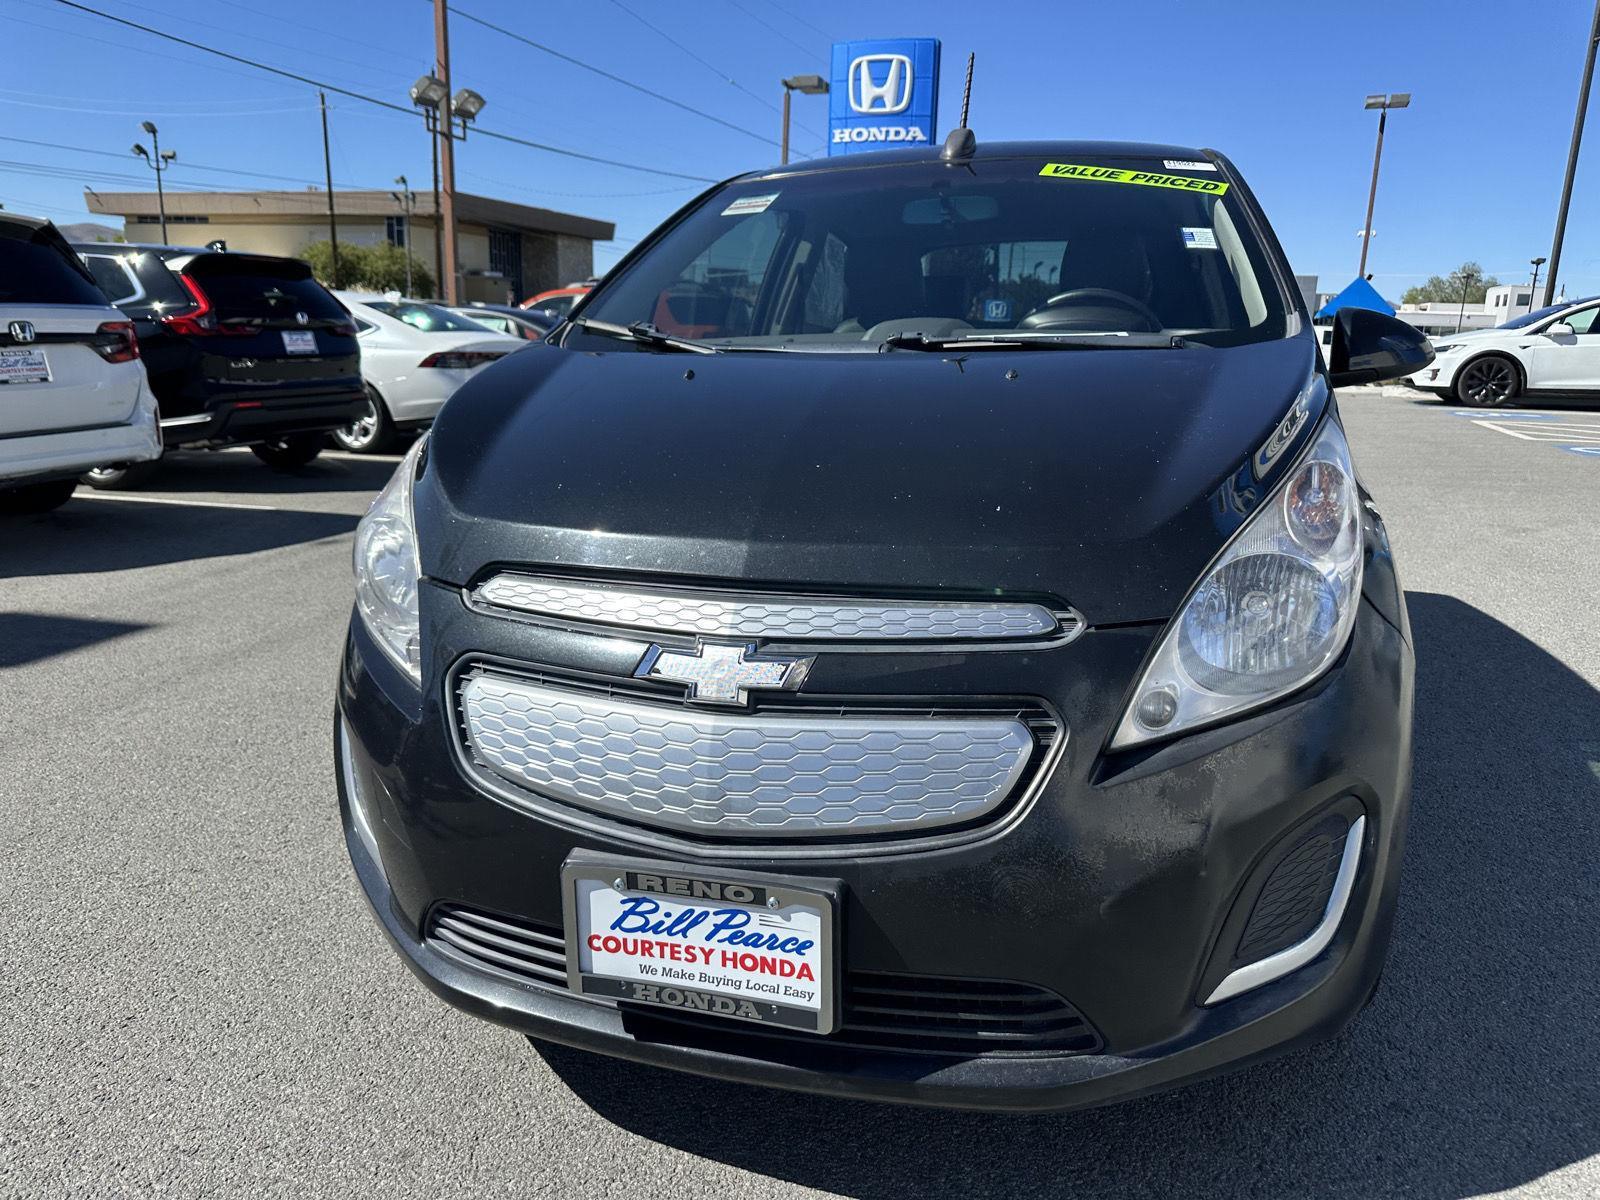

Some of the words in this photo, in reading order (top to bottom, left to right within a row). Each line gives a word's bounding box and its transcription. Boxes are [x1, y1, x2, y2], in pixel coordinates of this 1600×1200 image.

[832, 126, 927, 143] HONDA
[1052, 165, 1123, 181] VALUE
[1130, 173, 1220, 192] PRICED
[637, 874, 755, 903] RENO
[610, 896, 710, 939] Bill
[704, 908, 815, 956] Pearce
[587, 934, 715, 965] COURTESY
[721, 949, 815, 982] HONDA
[639, 963, 658, 976] We
[661, 966, 695, 981] Make
[699, 972, 742, 990] Buying
[745, 978, 780, 994] Local
[784, 985, 815, 1002] Easy
[633, 983, 763, 1020] HONDA
